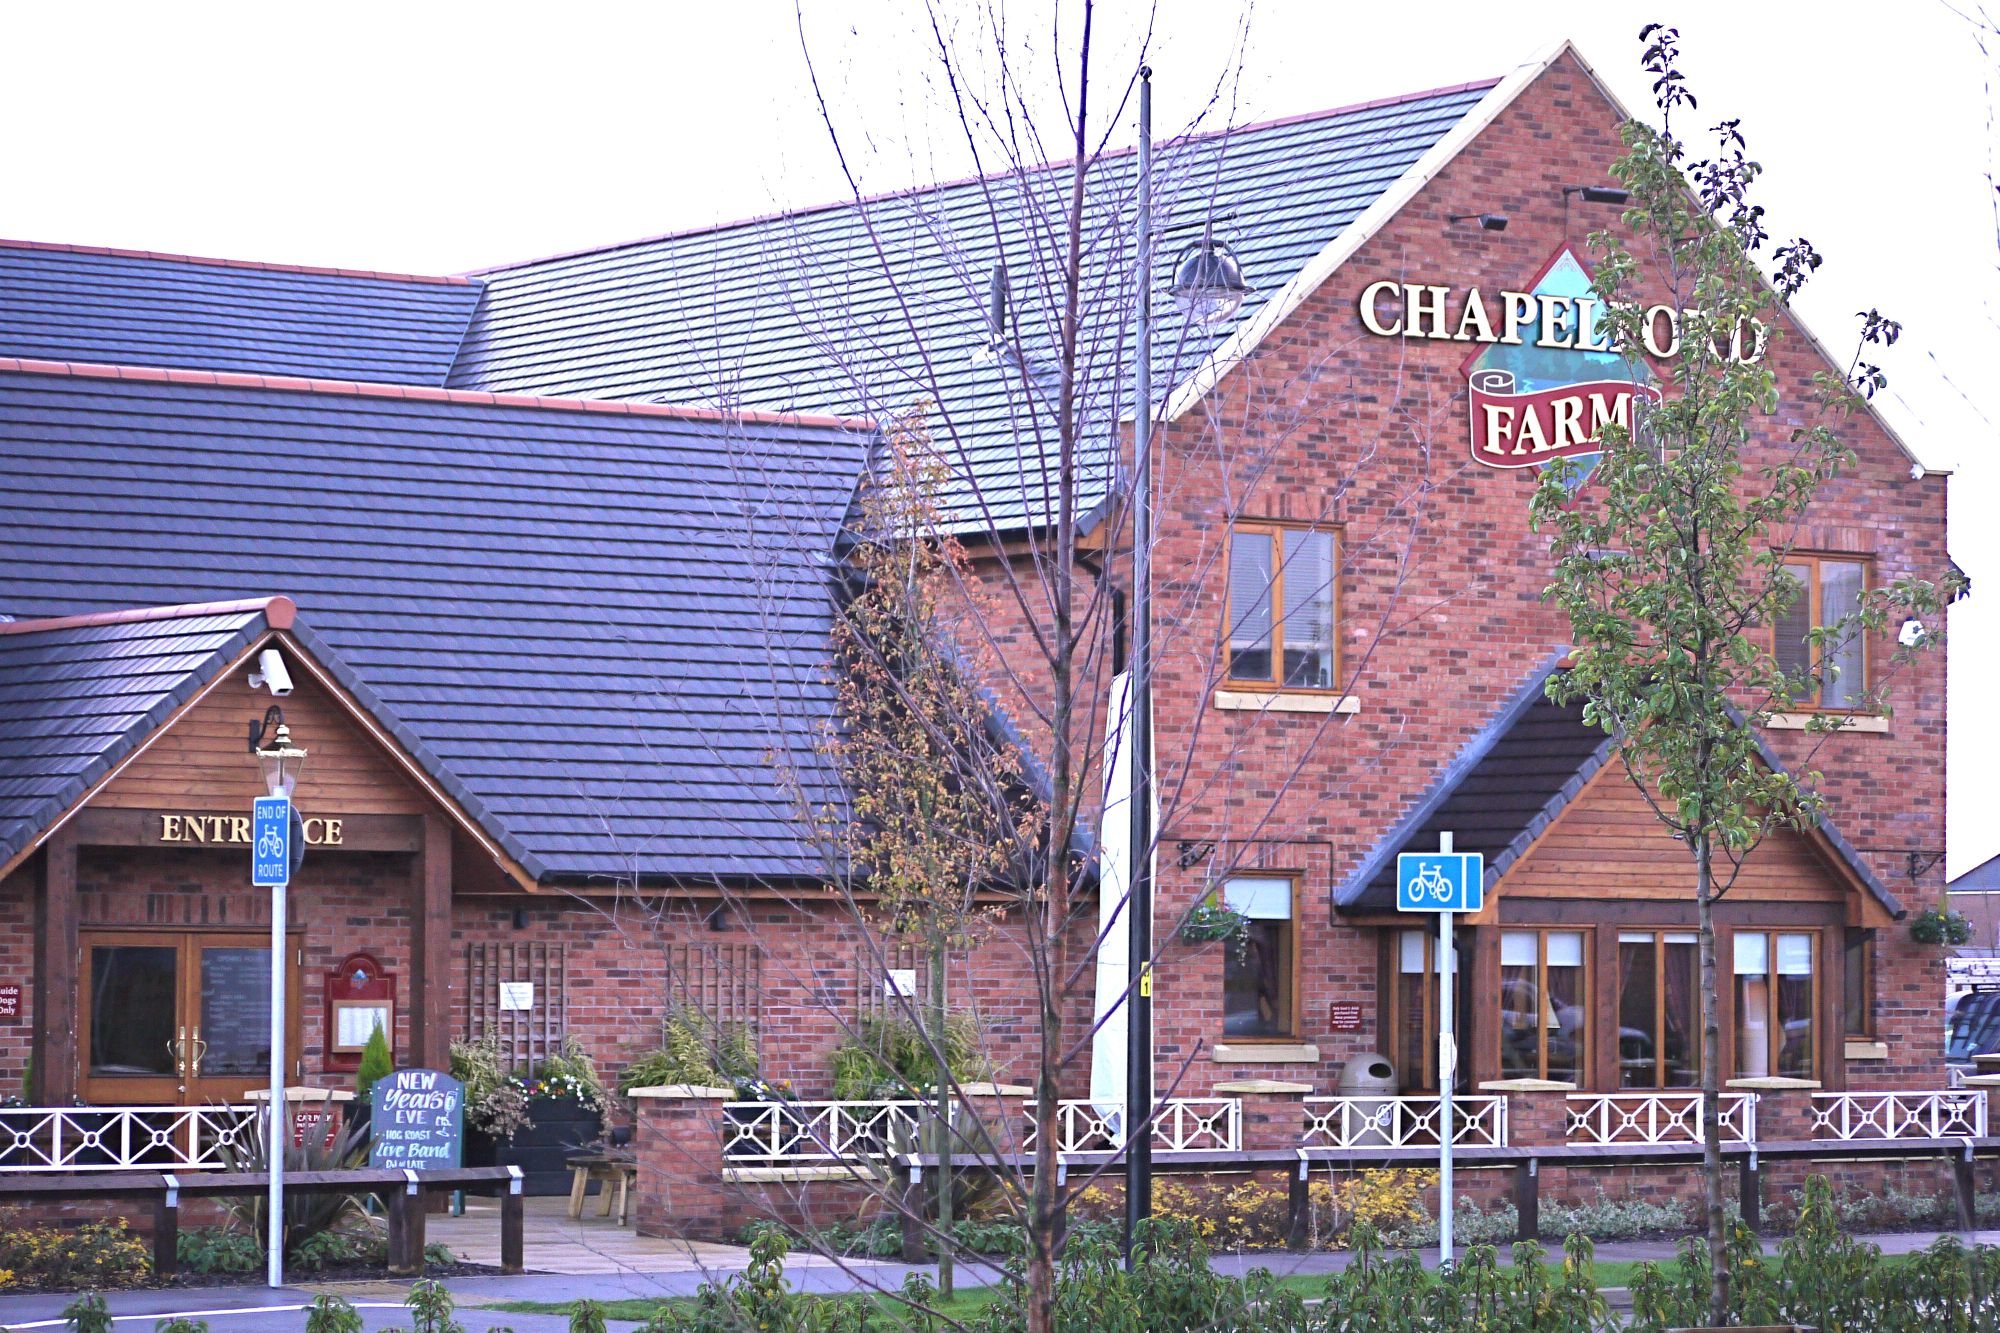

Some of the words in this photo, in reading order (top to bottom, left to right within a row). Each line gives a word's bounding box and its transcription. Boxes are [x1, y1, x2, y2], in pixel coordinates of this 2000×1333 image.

[1359, 280, 1767, 365] CHAPELOD
[1481, 391, 1633, 456] FARM
[257, 806, 273, 819] END
[275, 805, 286, 818] OF
[160, 815, 343, 845] ENTRCE
[258, 864, 283, 877] ROUTE
[0, 986, 19, 995] uide
[397, 1072, 438, 1090] NEW
[383, 1088, 444, 1111] Years
[395, 1110, 428, 1125] EVE
[385, 1130, 402, 1140] HOG
[404, 1130, 431, 1140] ROAST
[376, 1142, 406, 1157] Live
[407, 1142, 451, 1158] Band
[406, 1160, 427, 1170] LATE
